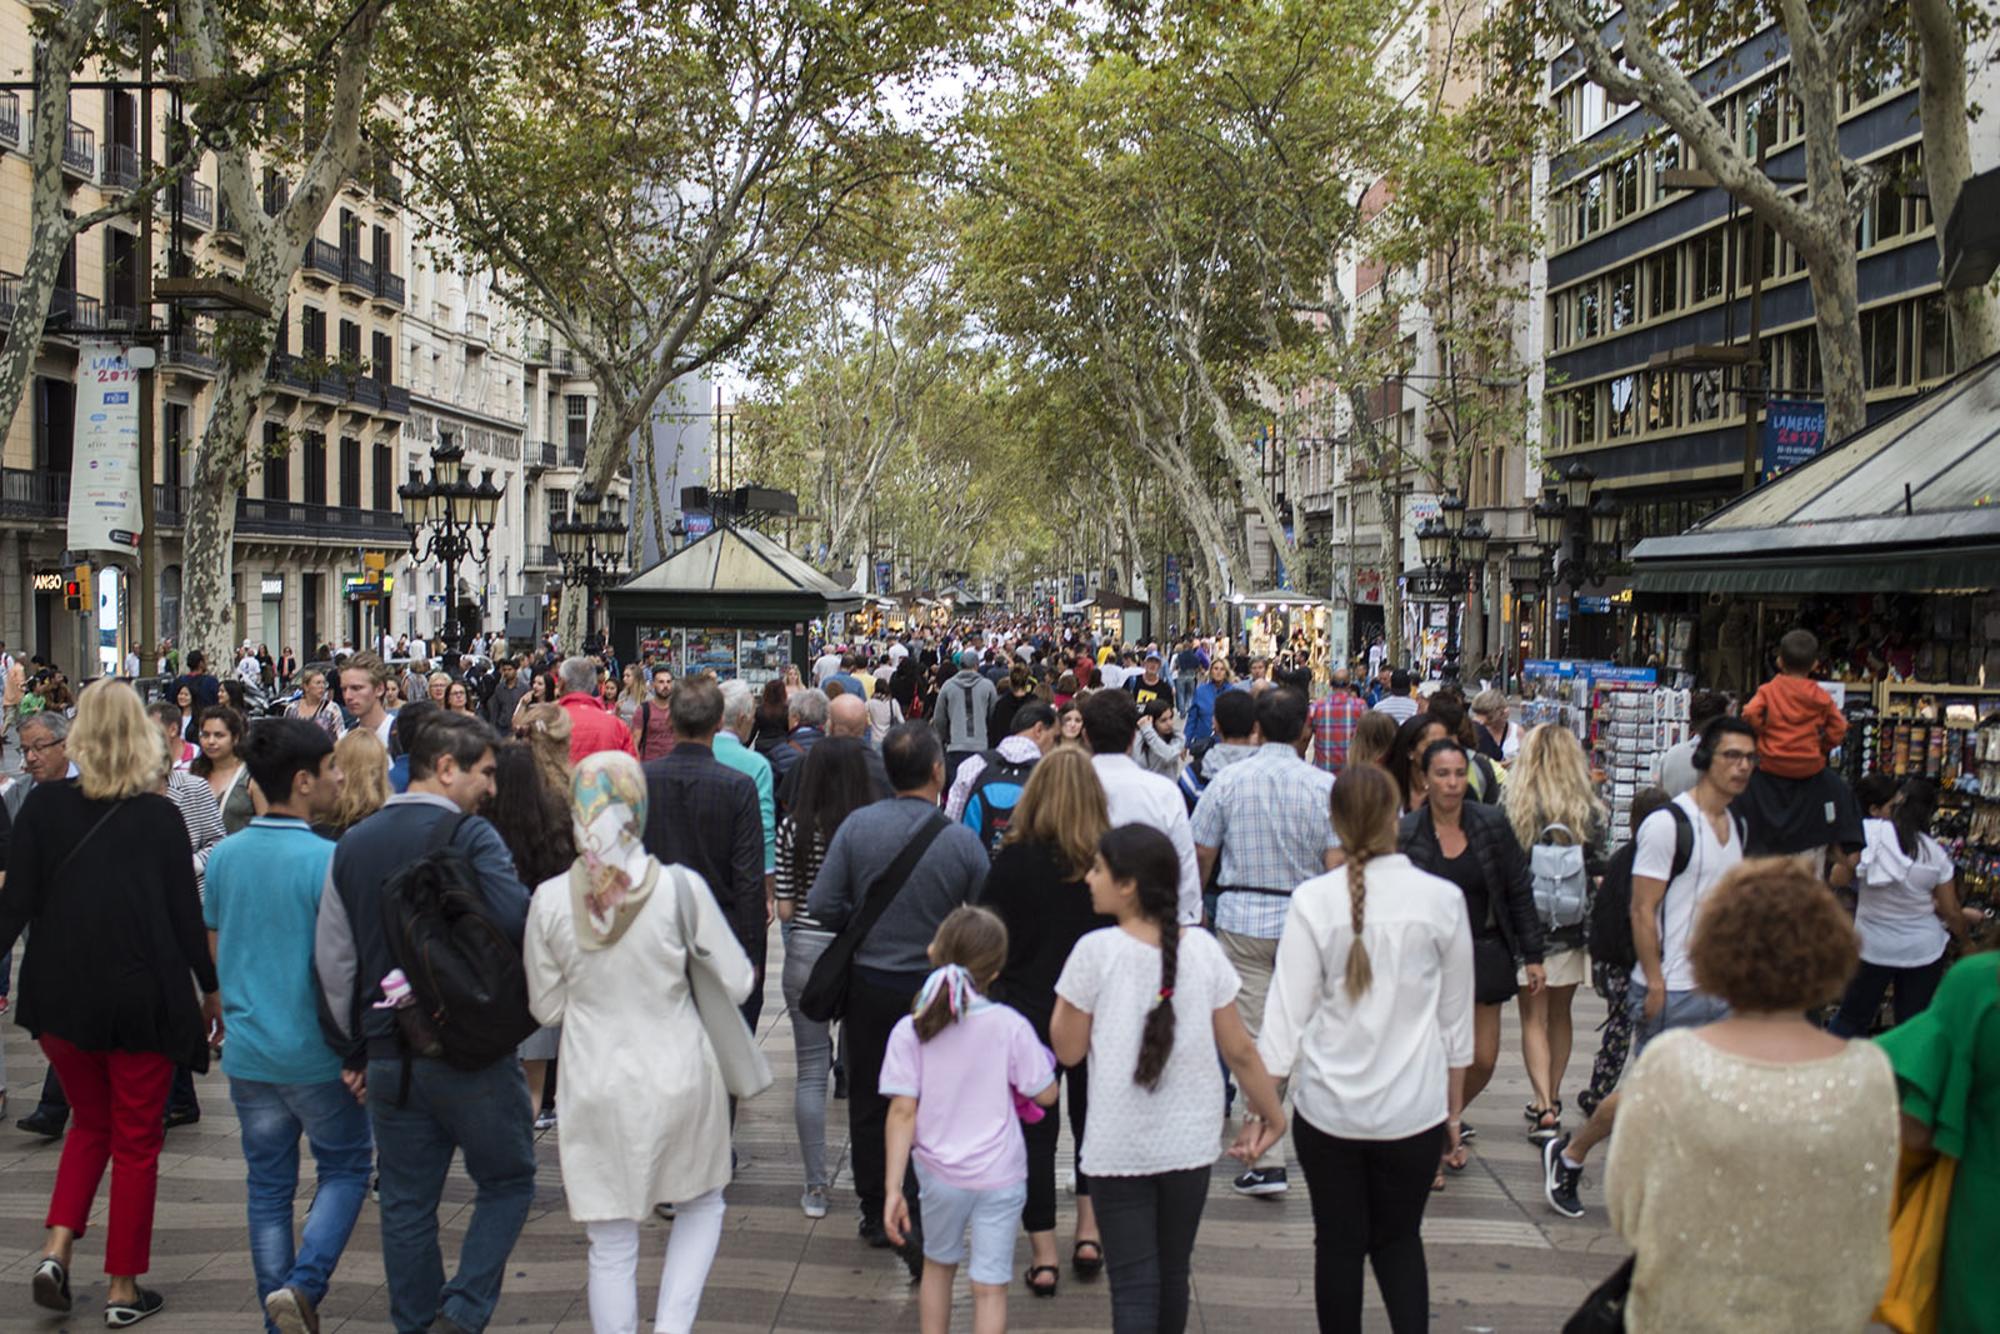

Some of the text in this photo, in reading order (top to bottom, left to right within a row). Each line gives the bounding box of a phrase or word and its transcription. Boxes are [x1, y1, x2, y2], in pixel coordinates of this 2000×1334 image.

[97, 369, 139, 383] 2017
[1778, 429, 1818, 446] 2017
[32, 574, 62, 590] ANGO
